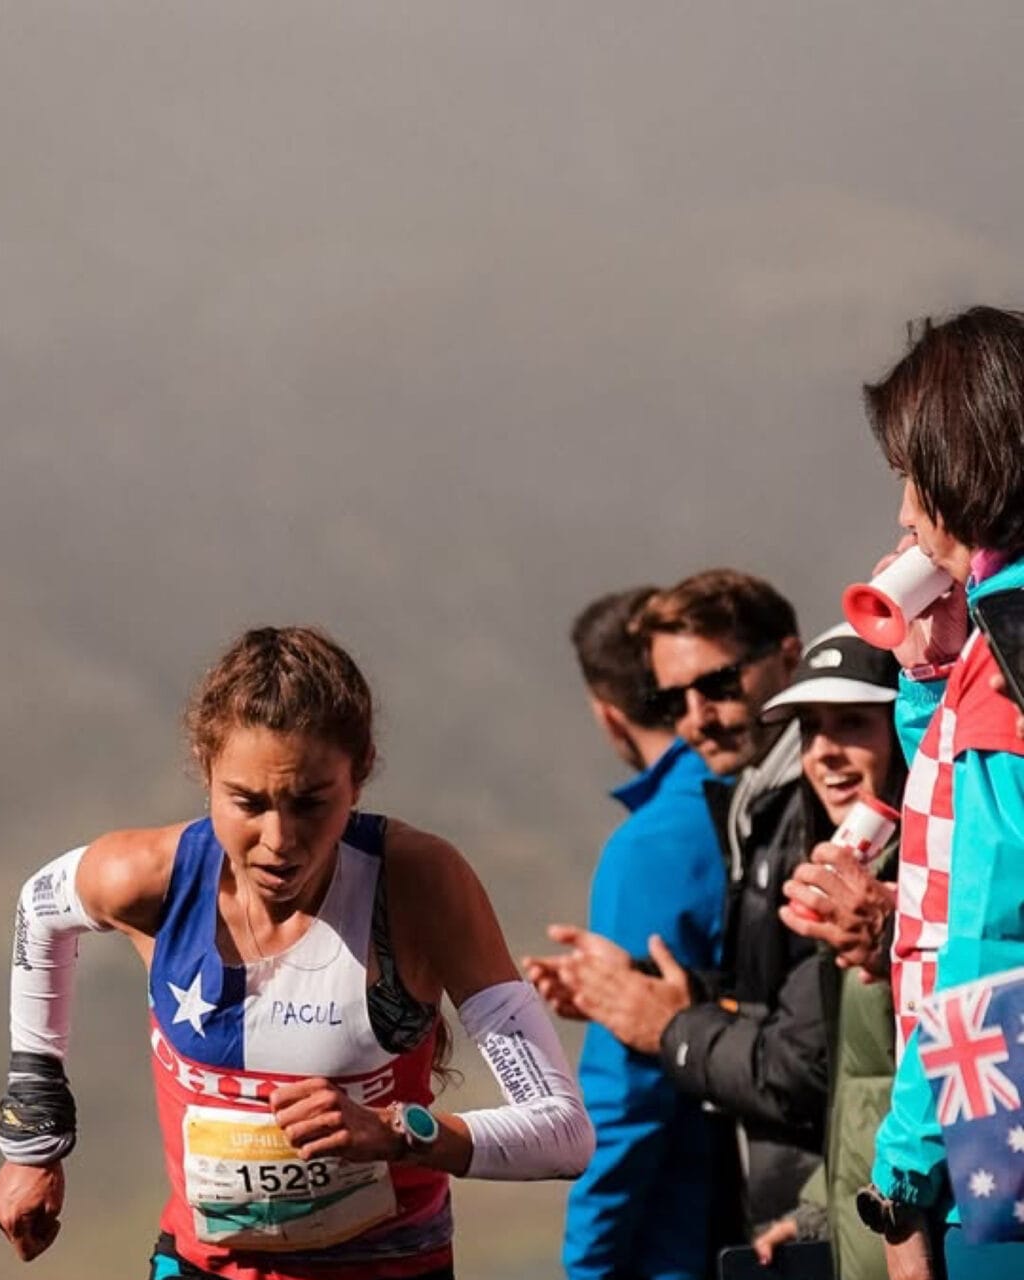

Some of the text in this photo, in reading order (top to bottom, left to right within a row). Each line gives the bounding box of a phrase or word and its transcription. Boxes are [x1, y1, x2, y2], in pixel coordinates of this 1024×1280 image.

[271, 1001, 342, 1026] PACUL
[150, 1030, 395, 1107] CHIE
[484, 1038, 529, 1104] ANFRANC
[236, 1162, 330, 1193] 1523
